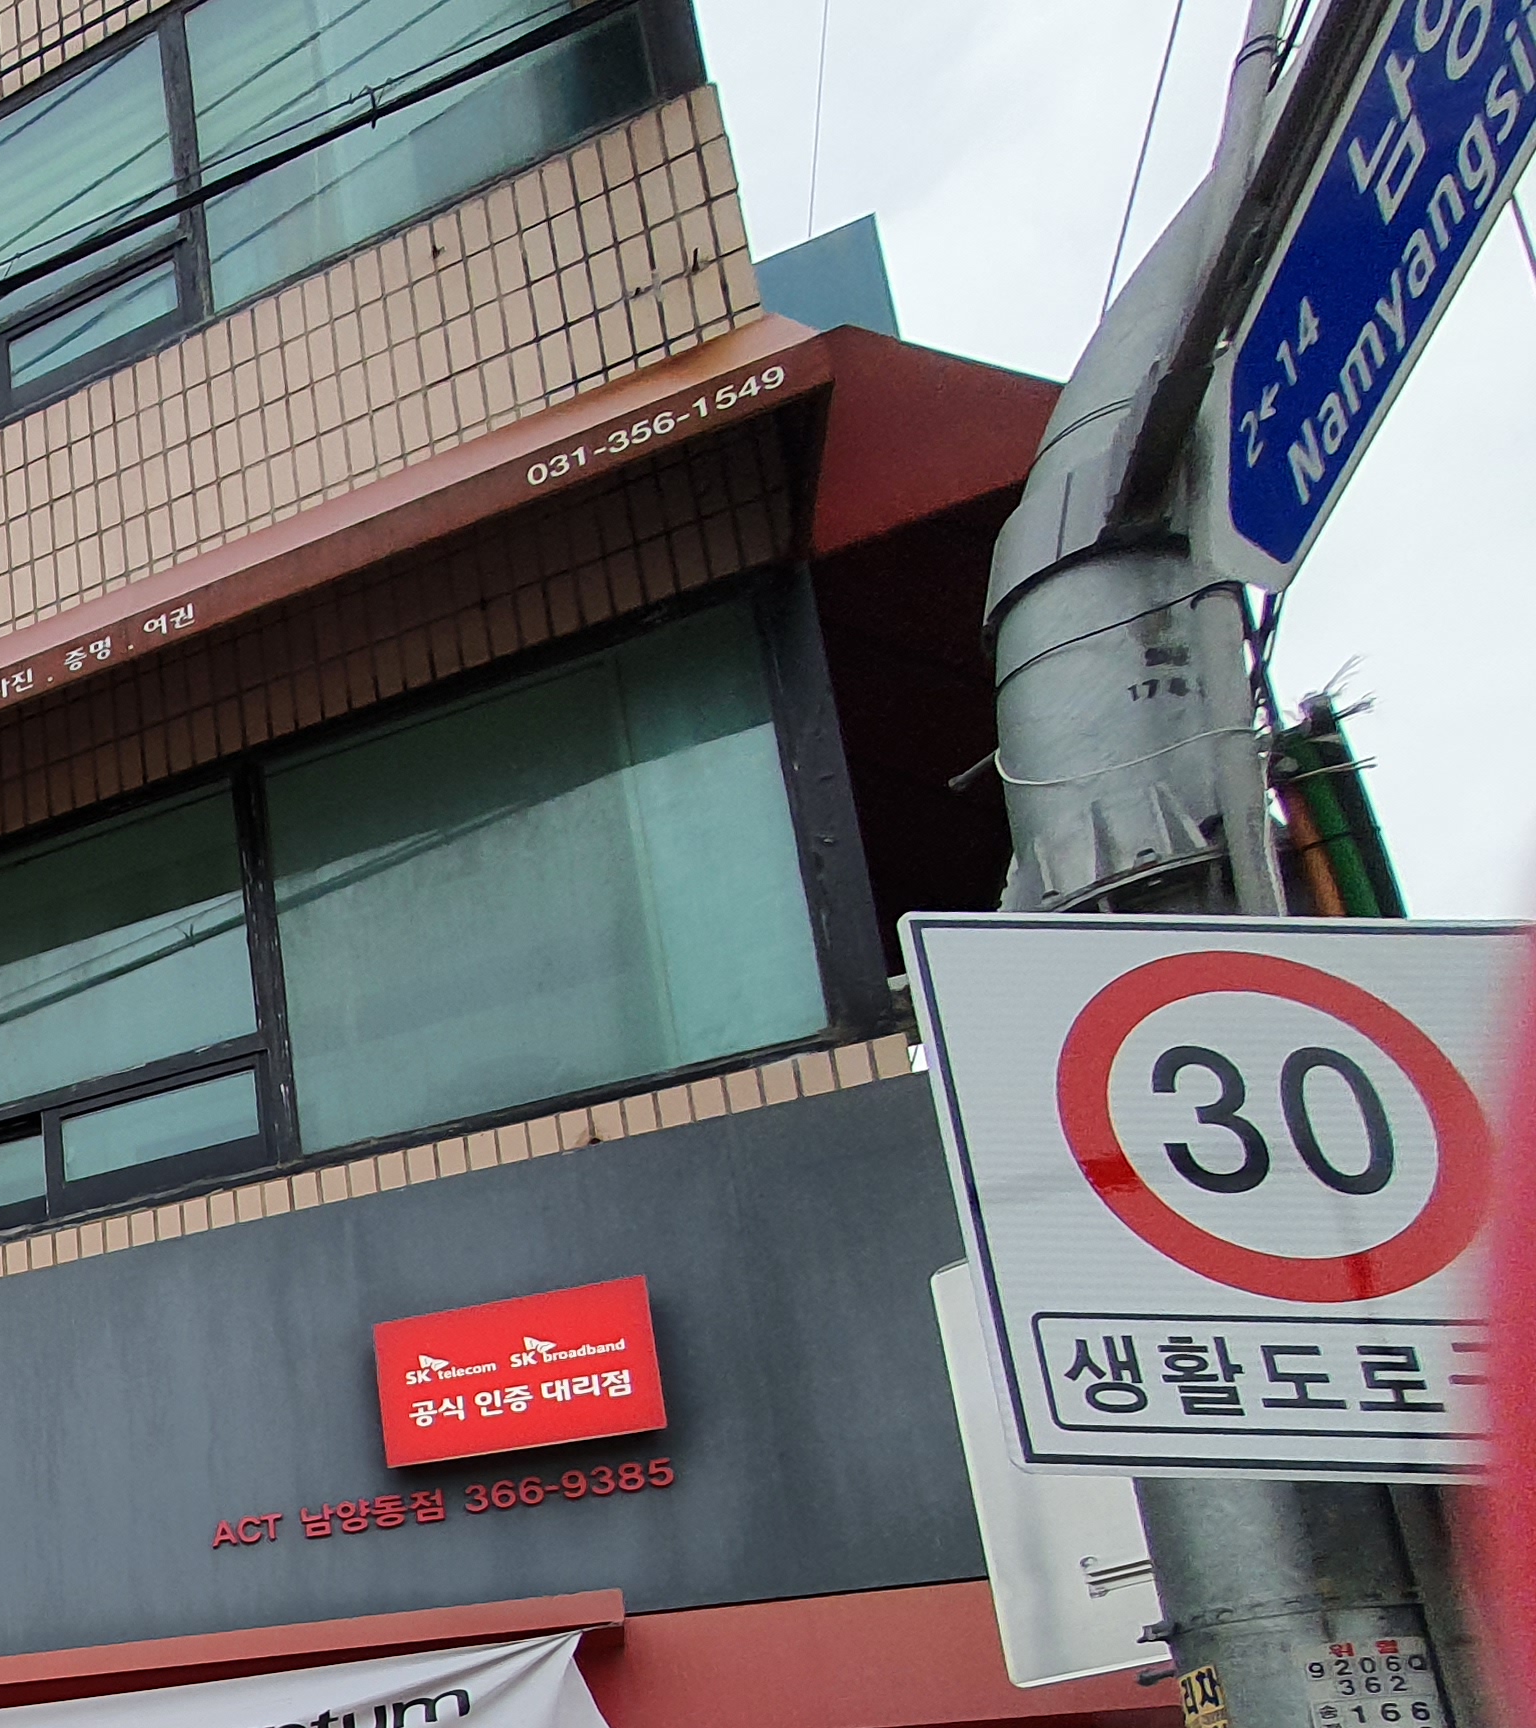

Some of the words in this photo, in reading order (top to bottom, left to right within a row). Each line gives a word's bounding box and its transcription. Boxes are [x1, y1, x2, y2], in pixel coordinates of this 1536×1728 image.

[1287, 0, 1536, 504] Namyangsi
[527, 366, 785, 485] 031-356-1549
[64, 636, 111, 671] 증명
[143, 603, 195, 635] 여권
[1151, 1045, 1395, 1195] 30
[405, 1369, 431, 1385] SK
[437, 1360, 497, 1381] telecom
[509, 1350, 537, 1367] SK
[543, 1338, 625, 1363] broadband
[408, 1395, 466, 1427] 공식
[474, 1385, 533, 1418] 인증
[540, 1369, 633, 1402] 대리점
[211, 1513, 282, 1549] ACT
[299, 1488, 447, 1540] 남양동점
[464, 1457, 675, 1514] 366-9385
[1341, 1676, 1407, 1696] 362
[1353, 1701, 1431, 1724] 166
